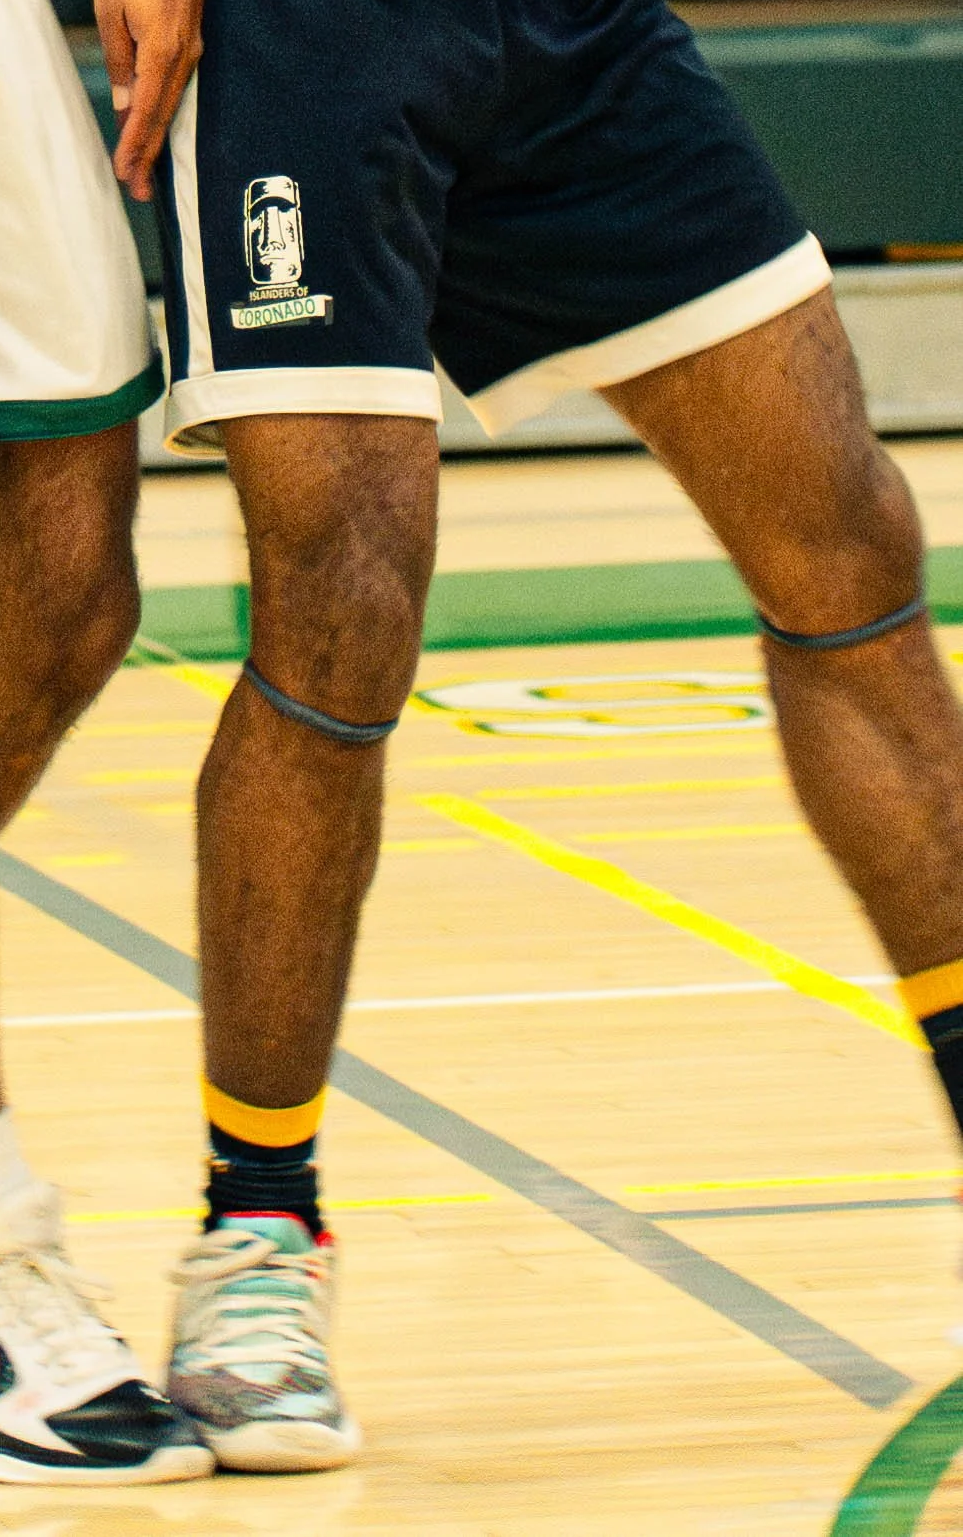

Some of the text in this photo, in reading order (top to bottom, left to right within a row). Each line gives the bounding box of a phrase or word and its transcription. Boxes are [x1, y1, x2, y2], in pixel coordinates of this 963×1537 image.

[249, 285, 309, 302] ISLANDERS OF
[238, 298, 316, 327] CORONADO
